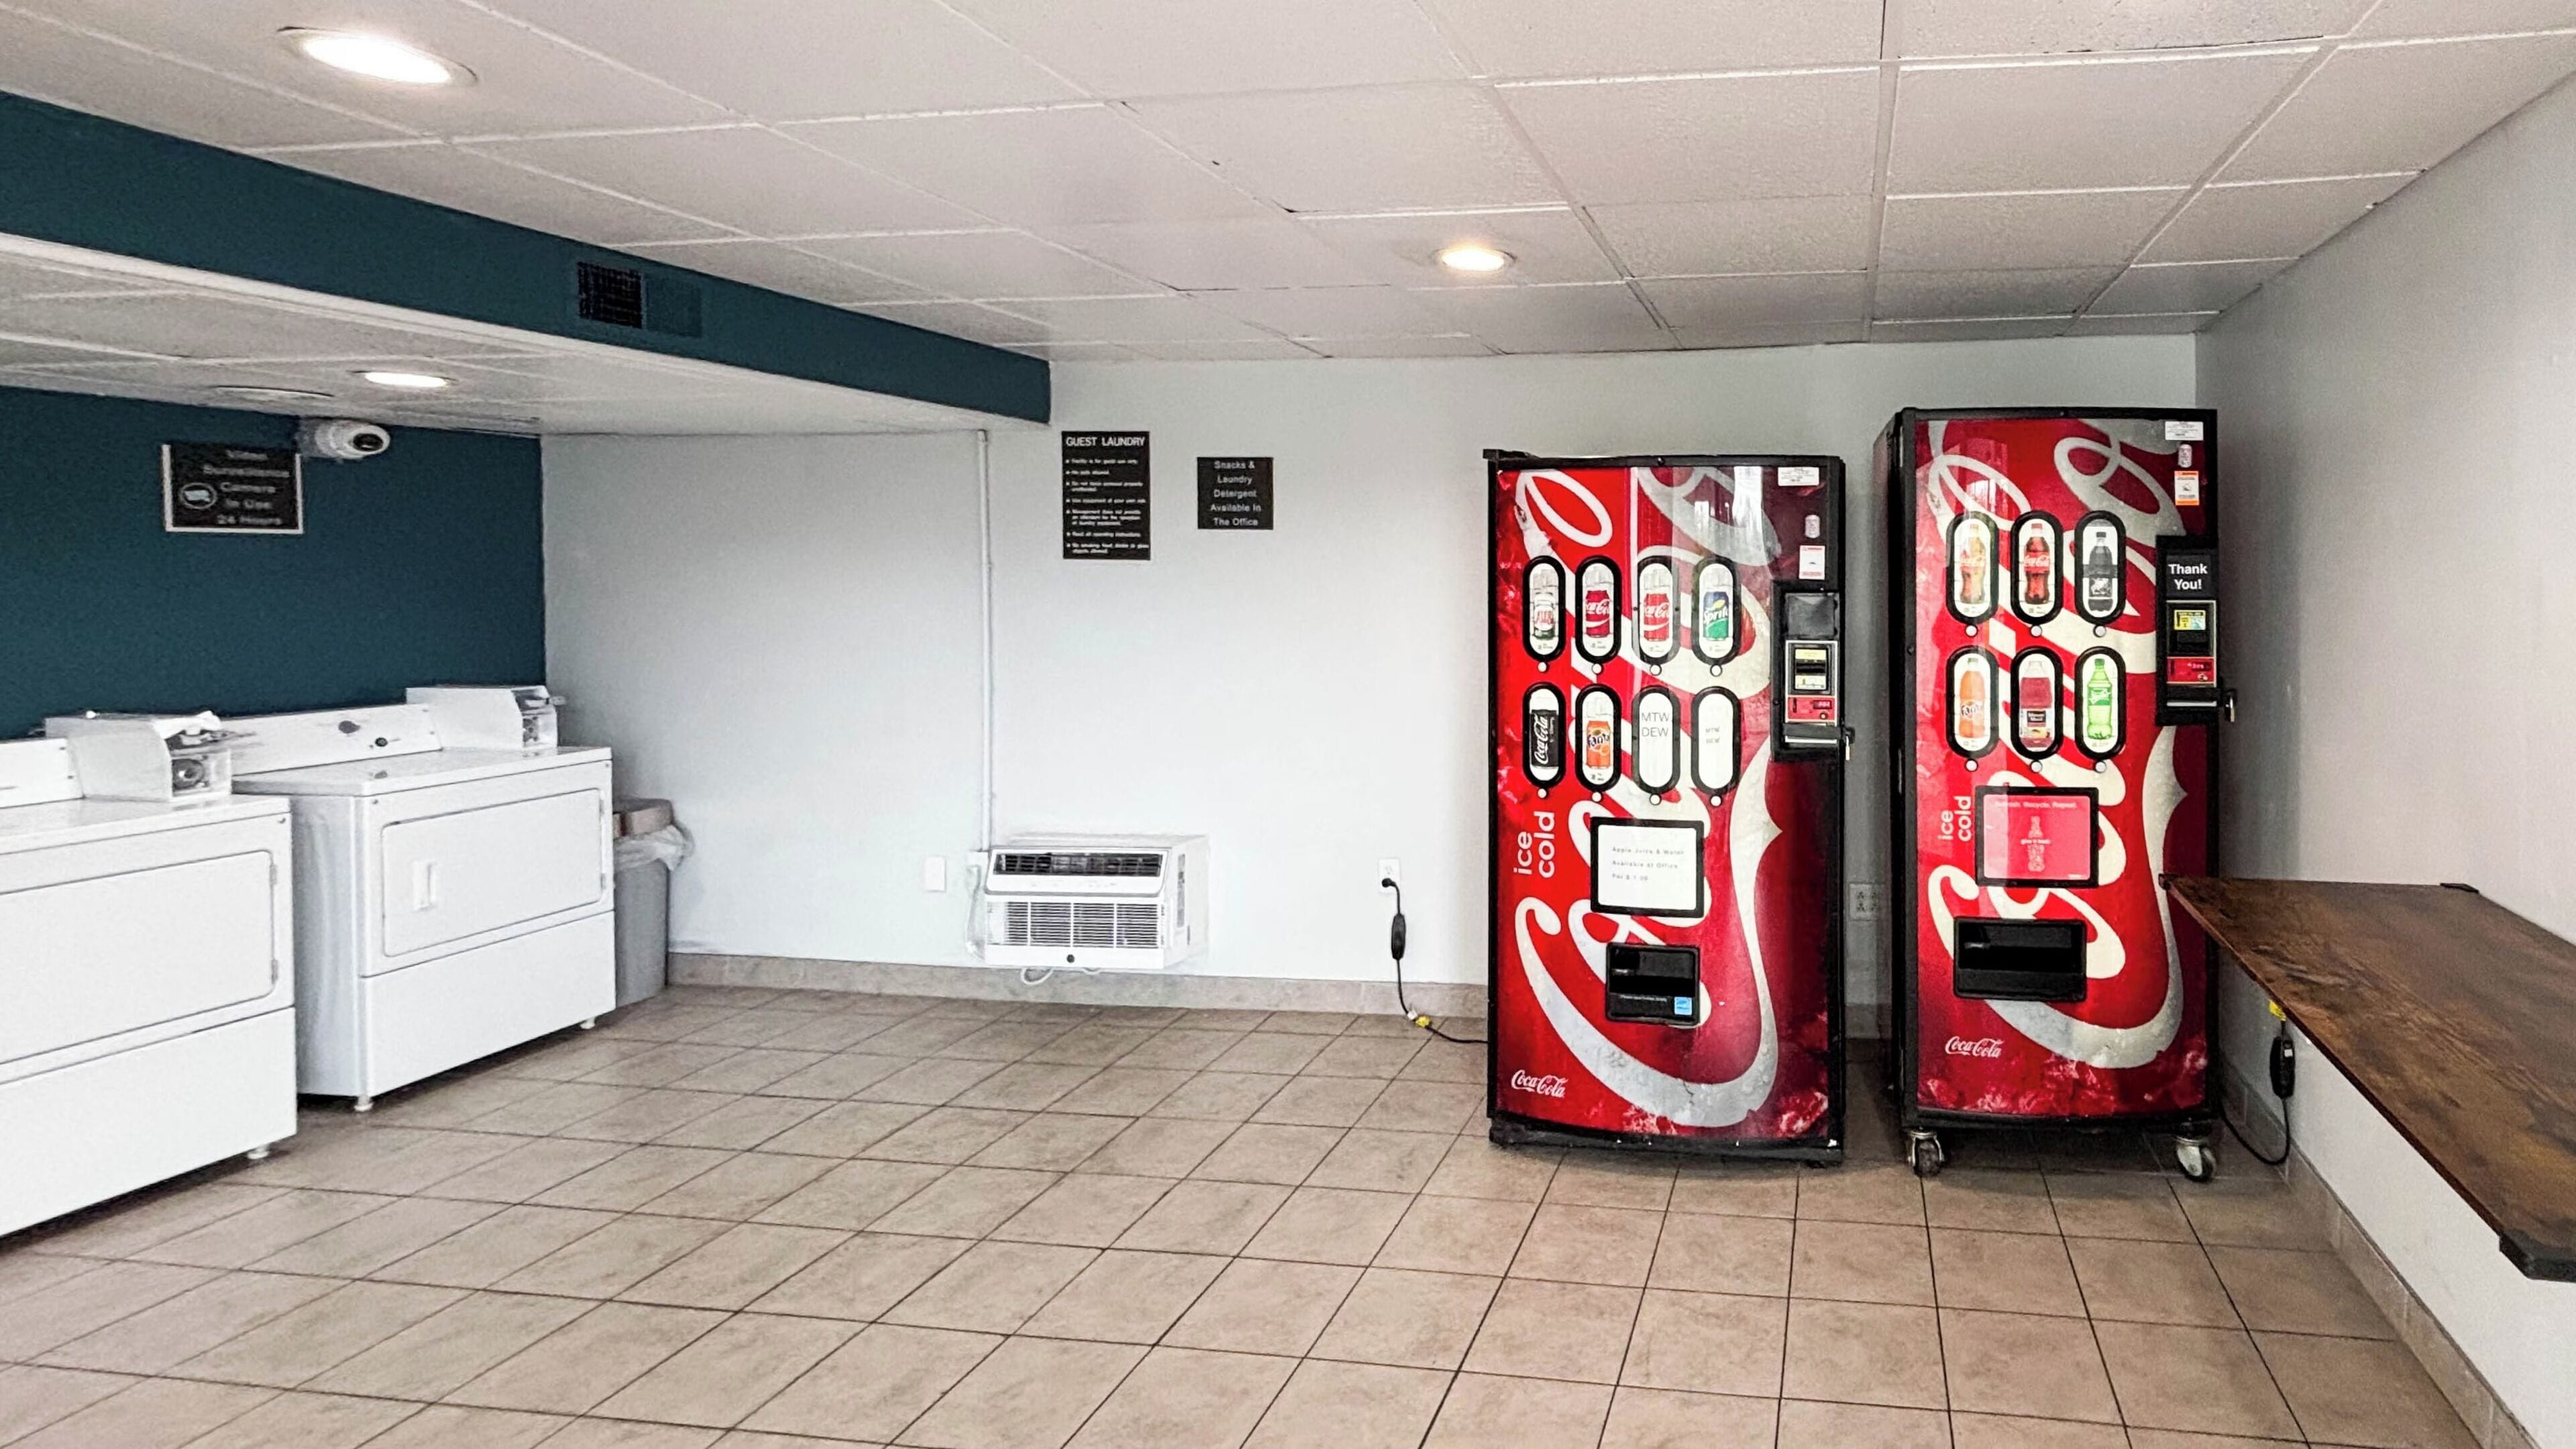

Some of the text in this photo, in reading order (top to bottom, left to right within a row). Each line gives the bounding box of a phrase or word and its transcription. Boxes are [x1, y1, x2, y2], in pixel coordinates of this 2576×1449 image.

[1065, 437, 1145, 447] GUEST LAUNDRY
[1214, 460, 1255, 469] Snacks &
[1217, 475, 1252, 486] Laundry
[1214, 489, 1257, 499] Detergent
[1210, 504, 1250, 512] Available
[1213, 517, 1258, 526] The Office
[2168, 564, 2208, 574] Thank
[2174, 579, 2202, 590] You!
[1642, 712, 1670, 722] MTW
[1642, 727, 1669, 737] DEW
[1954, 796, 1972, 842] cold
[1938, 810, 1953, 840] ice
[1534, 811, 1555, 878] cold
[1513, 831, 1532, 875] ice
[1945, 1036, 2004, 1058] Coca-Cola
[1511, 1070, 1568, 1098] Coca-Cola
